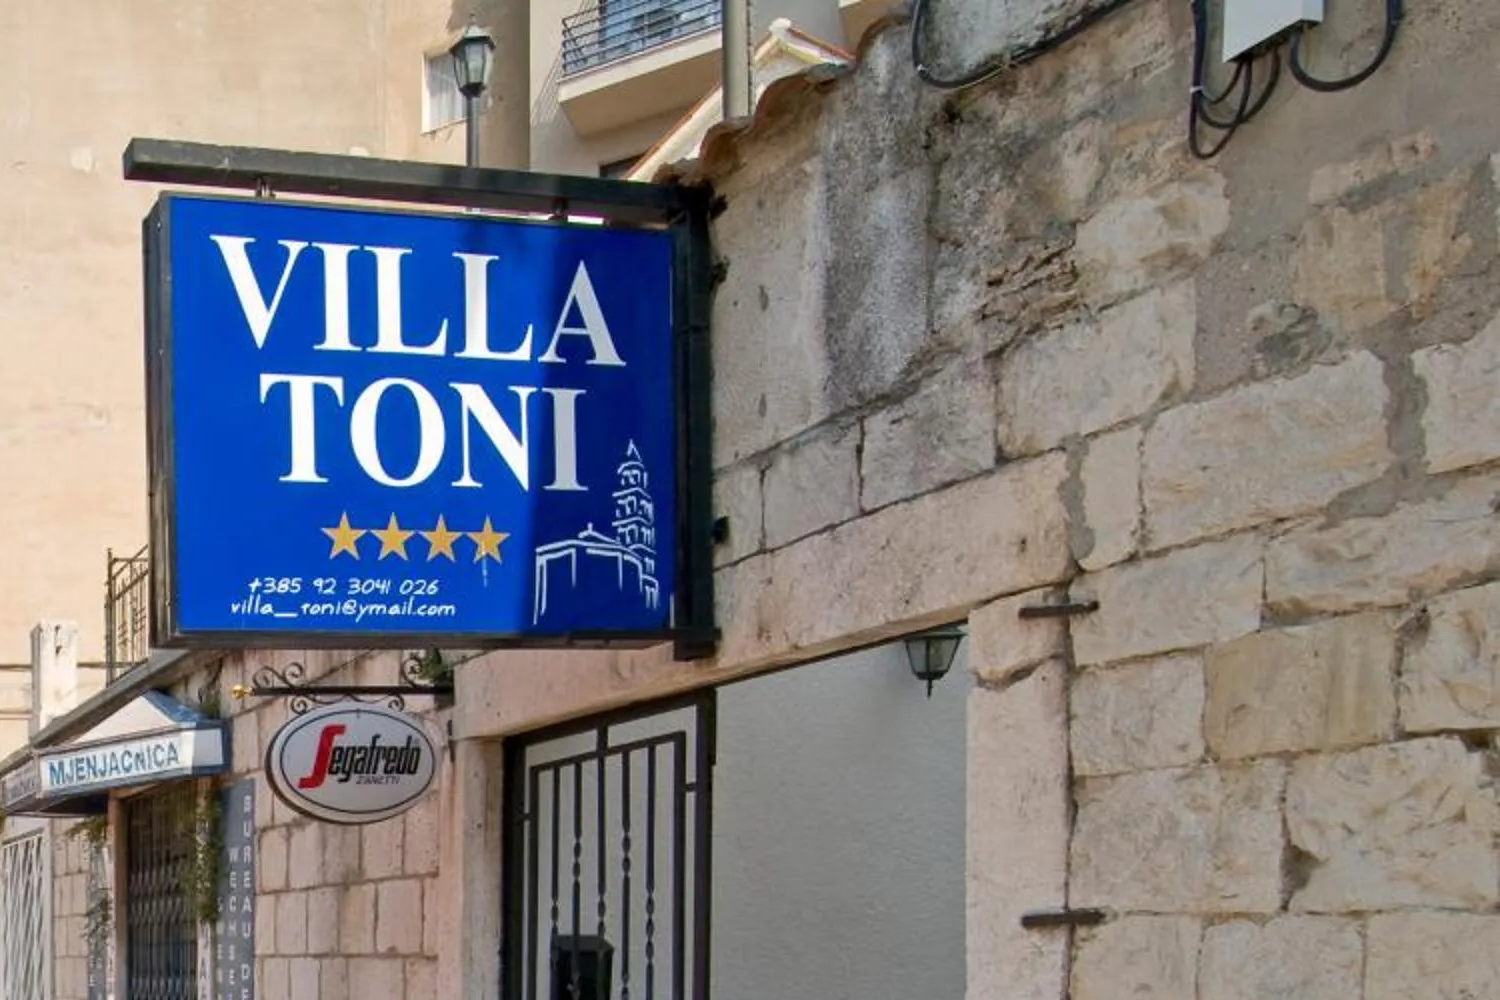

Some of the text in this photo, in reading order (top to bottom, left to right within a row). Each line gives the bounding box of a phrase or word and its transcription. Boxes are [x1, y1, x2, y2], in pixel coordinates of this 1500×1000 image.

[209, 234, 627, 367] VILLA
[260, 373, 589, 493] TONI
[248, 577, 439, 595] +385 92 3041 026
[298, 723, 422, 789] Segafredo
[355, 775, 401, 785] ZANETTI
[241, 795, 253, 939] BUREAU
